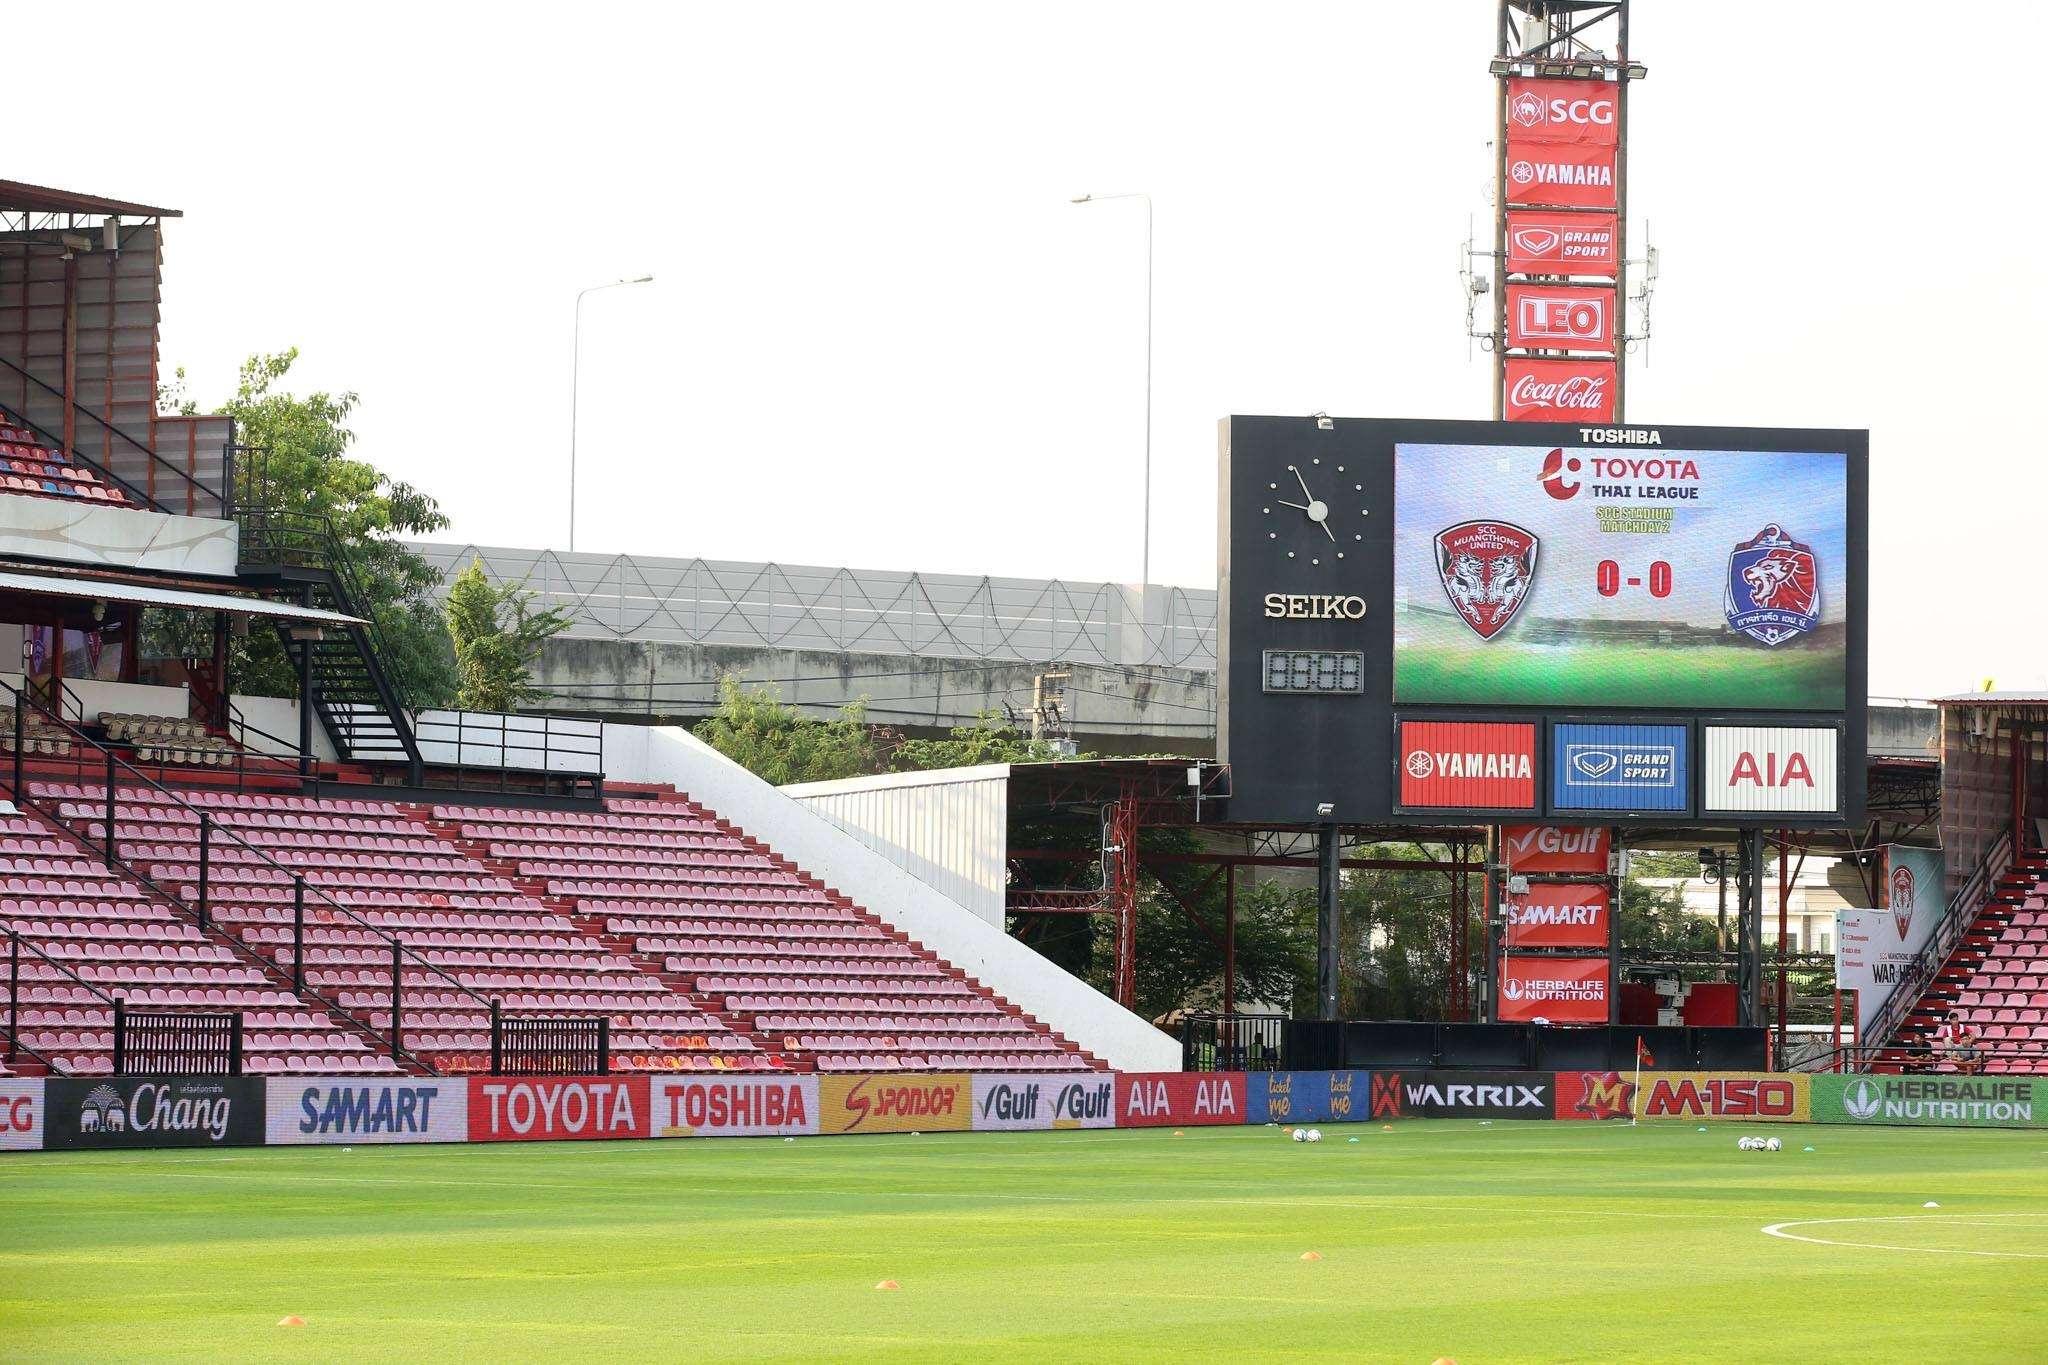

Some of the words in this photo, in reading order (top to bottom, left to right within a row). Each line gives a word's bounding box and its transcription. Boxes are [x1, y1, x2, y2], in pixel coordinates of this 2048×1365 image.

[1550, 99, 1613, 124] SCG
[1535, 163, 1611, 185] YAMAHA
[1564, 232, 1610, 243] GRAND
[1564, 246, 1608, 257] SPORT
[1522, 300, 1599, 336] LEO
[1579, 428, 1662, 444] TOSHIBA
[1591, 458, 1700, 480] TOYOTA
[1592, 485, 1632, 498] THAI
[1639, 486, 1699, 499] LEAGUE
[1596, 507, 1620, 519] SCG
[1622, 507, 1673, 520] STADIUM
[1477, 526, 1496, 534] SCG
[1600, 520, 1661, 533] MATCHDAY
[1454, 534, 1520, 548] MUANGTHONG
[1470, 541, 1504, 550] UNITED
[1264, 593, 1366, 619] SEIKO
[1437, 752, 1531, 779] YAMAHA
[1624, 754, 1669, 766] GRAND
[1728, 751, 1815, 787] AIA
[1624, 767, 1669, 778] SPORT
[1537, 826, 1601, 853] Gulf
[1508, 905, 1602, 925] SAMART
[1872, 963, 1896, 984] WAR
[1525, 980, 1603, 990] HERBALIFE
[1525, 991, 1603, 1000] NUTRITION
[1269, 1073, 1291, 1094] ticket
[1330, 1073, 1352, 1093] ticket
[1885, 1081, 2033, 1100] HERBALIFE
[996, 1084, 1038, 1120] Gulf
[1067, 1083, 1110, 1119] Gulf
[1127, 1080, 1170, 1117] AIA
[1194, 1080, 1235, 1115] AIA
[1331, 1096, 1351, 1115] me
[1406, 1084, 1546, 1107] WARRIX
[1645, 1079, 1796, 1116] M-150
[129, 1083, 231, 1141] Chang
[299, 1087, 438, 1134] SAMART
[483, 1083, 636, 1134] TOYOTA
[664, 1084, 806, 1128] TOSHIBA
[1269, 1097, 1290, 1116] me
[1885, 1101, 2033, 1121] NUTRITION
